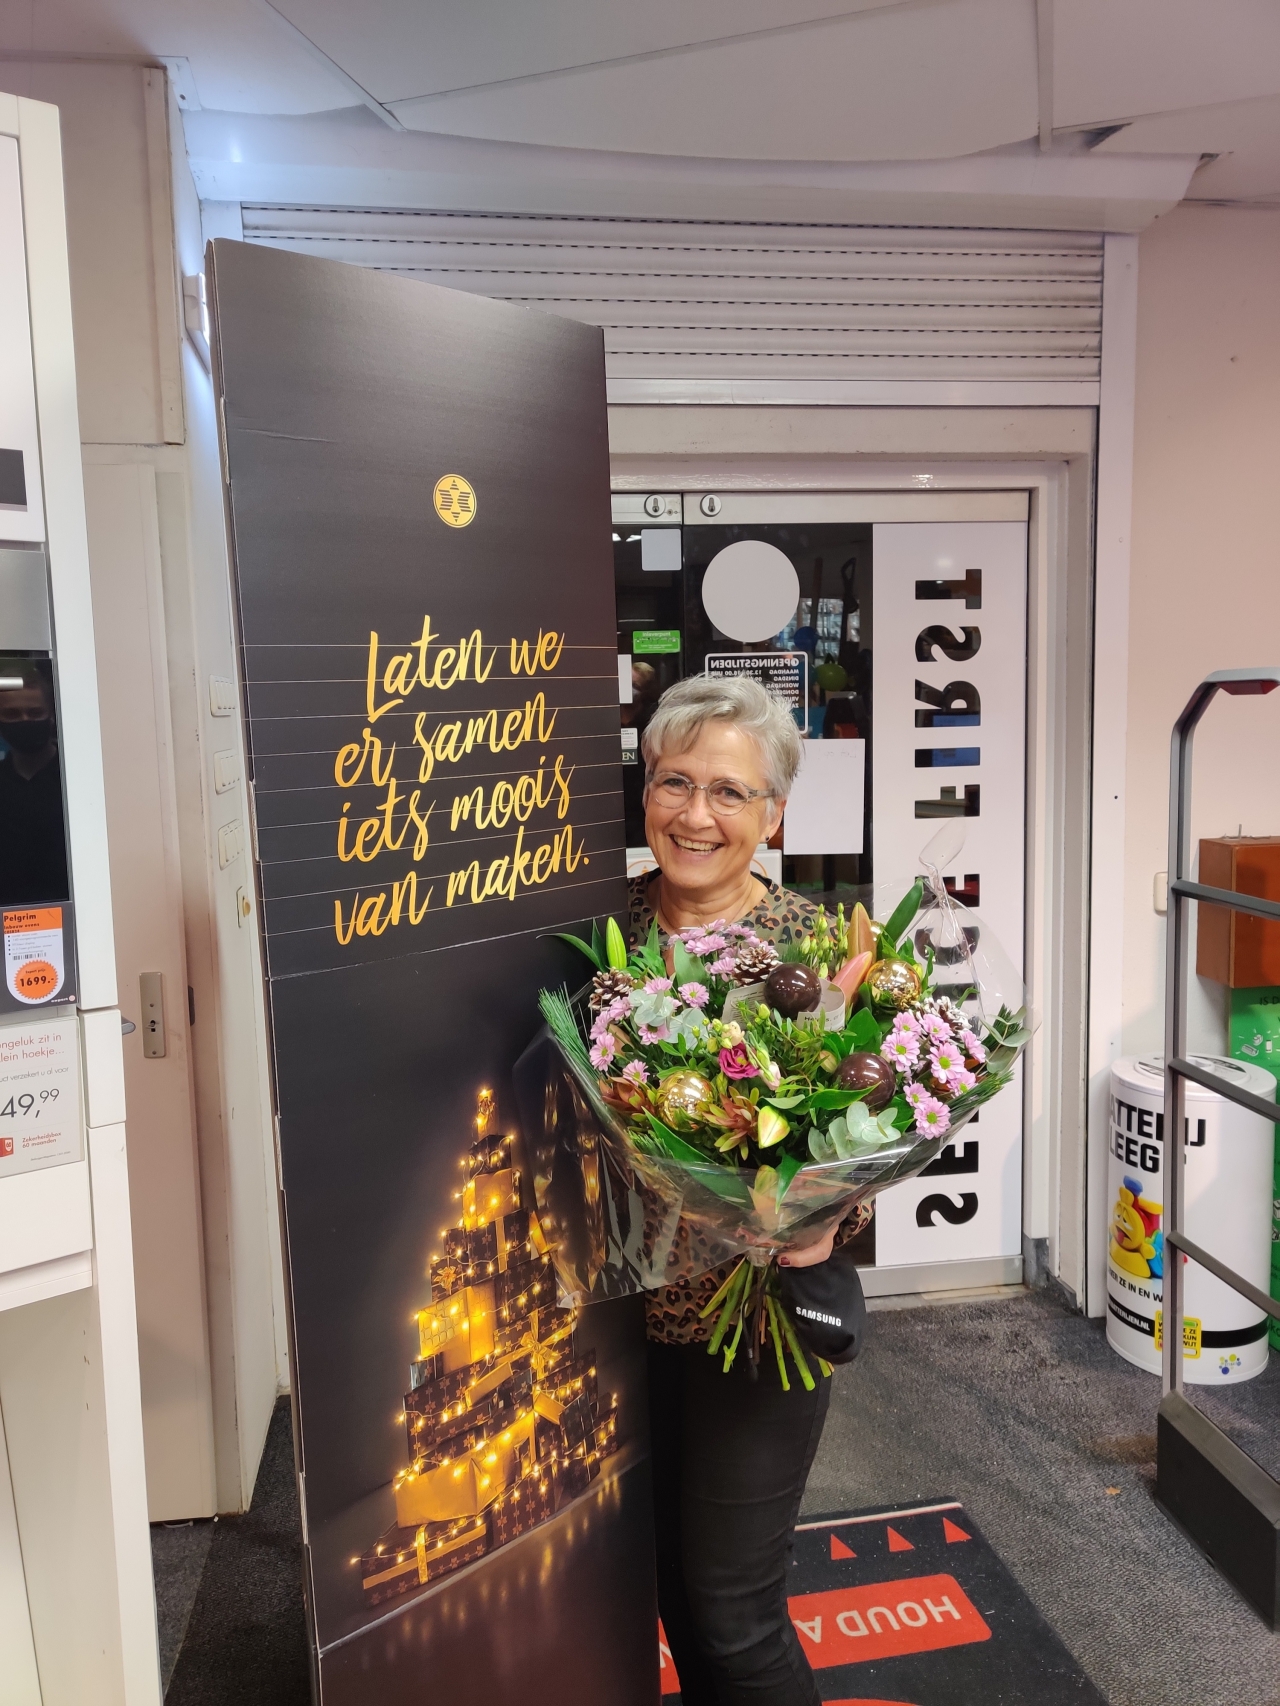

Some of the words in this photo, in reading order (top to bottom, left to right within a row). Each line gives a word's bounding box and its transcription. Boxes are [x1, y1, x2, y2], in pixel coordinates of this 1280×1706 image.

[366, 614, 497, 723] Laten
[510, 627, 565, 675] we
[335, 728, 396, 787] er
[413, 692, 558, 783] samen
[337, 777, 436, 861] iets
[451, 755, 575, 831] moois
[335, 871, 434, 945] van
[446, 824, 590, 907] maken.
[4, 913, 37, 923] Pelgrim
[0, 1035, 35, 1050] ngeluk
[38, 1034, 50, 1044] zit
[53, 1033, 62, 1042] in
[10, 1071, 40, 1081] verzekert
[46, 1067, 53, 1075] al
[54, 1066, 69, 1074] voor
[22, 1132, 62, 1143] Zekerheidsbox
[31, 1138, 57, 1147] maanden
[1119, 1276, 1127, 1288] ZE
[1128, 1281, 1137, 1294] IN
[1139, 1287, 1150, 1299] EN
[795, 1306, 842, 1327] SAMSUNG
[836, 1595, 962, 1637] HOUD
